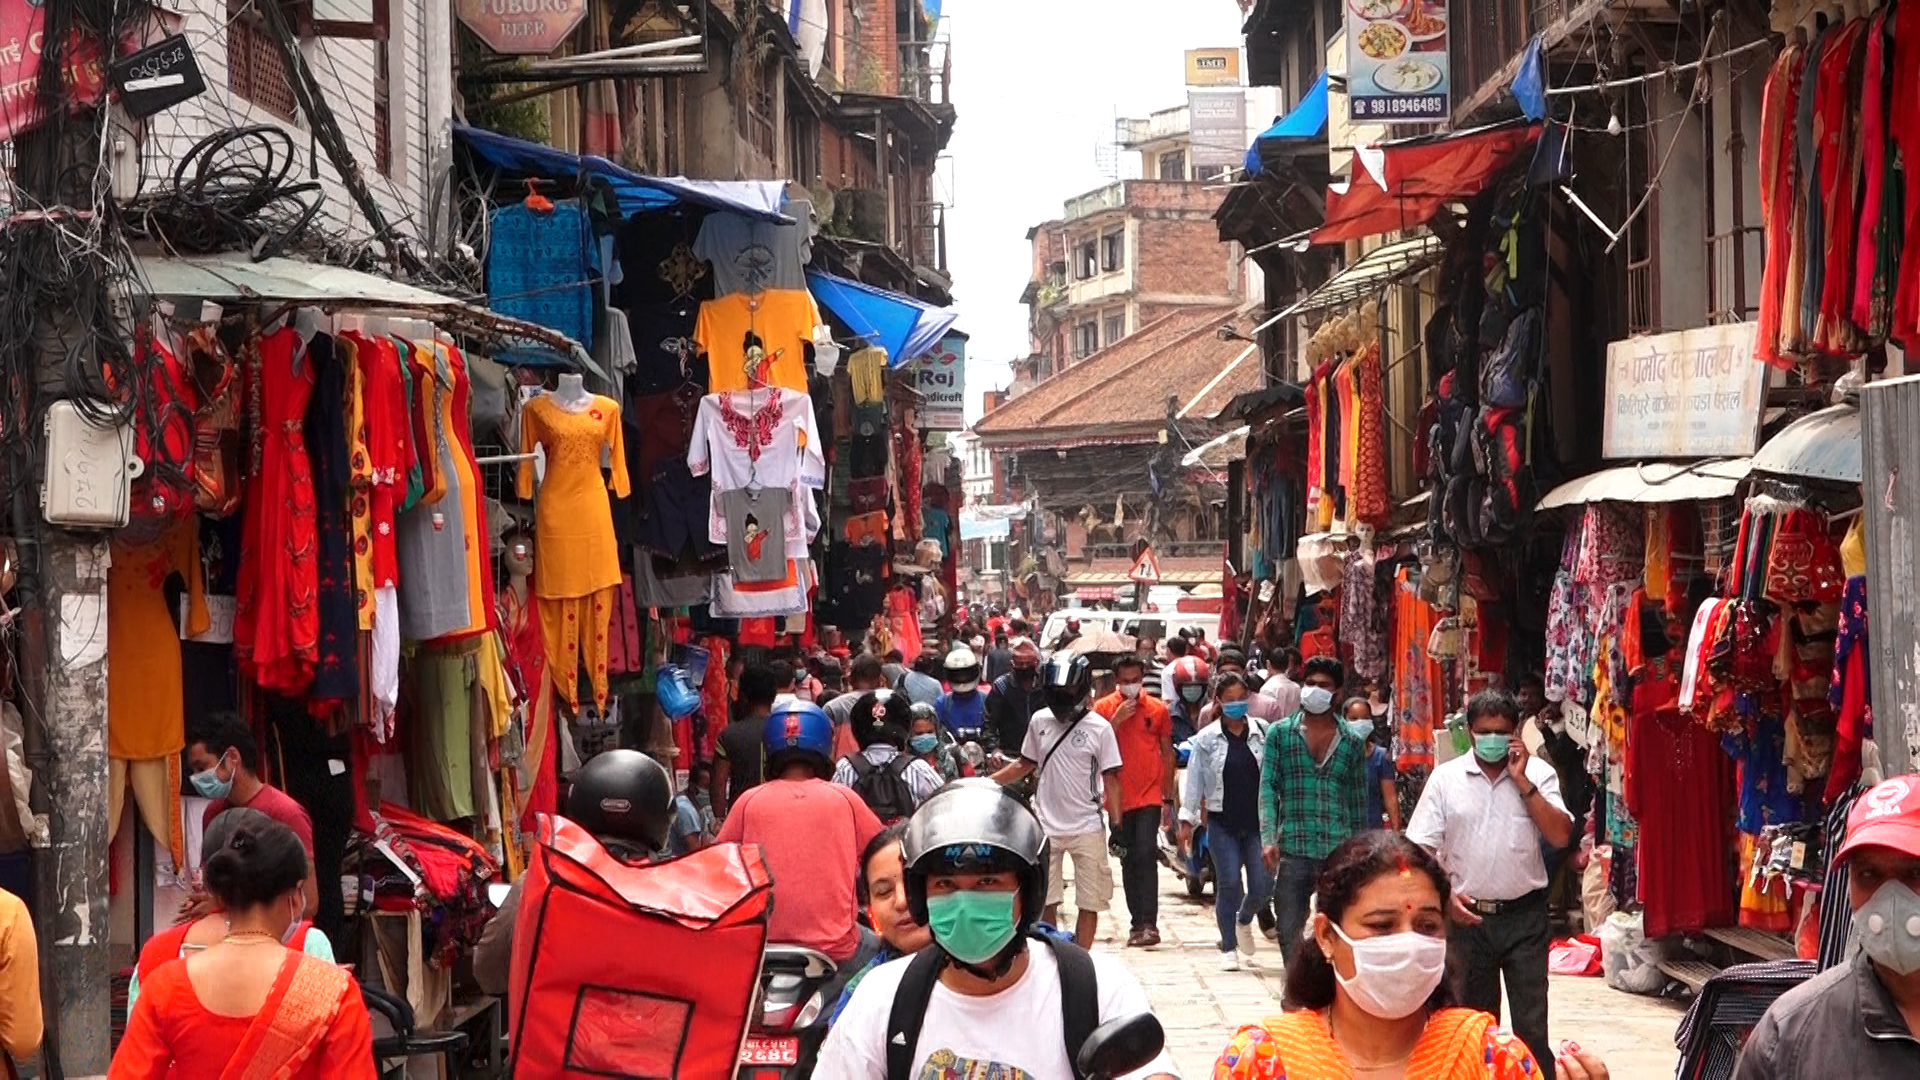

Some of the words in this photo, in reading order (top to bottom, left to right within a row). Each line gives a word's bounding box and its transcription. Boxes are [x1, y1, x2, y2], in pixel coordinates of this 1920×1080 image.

[501, 22, 545, 35] BEER
[1371, 97, 1441, 114] 9818946485
[919, 369, 954, 387] Raj
